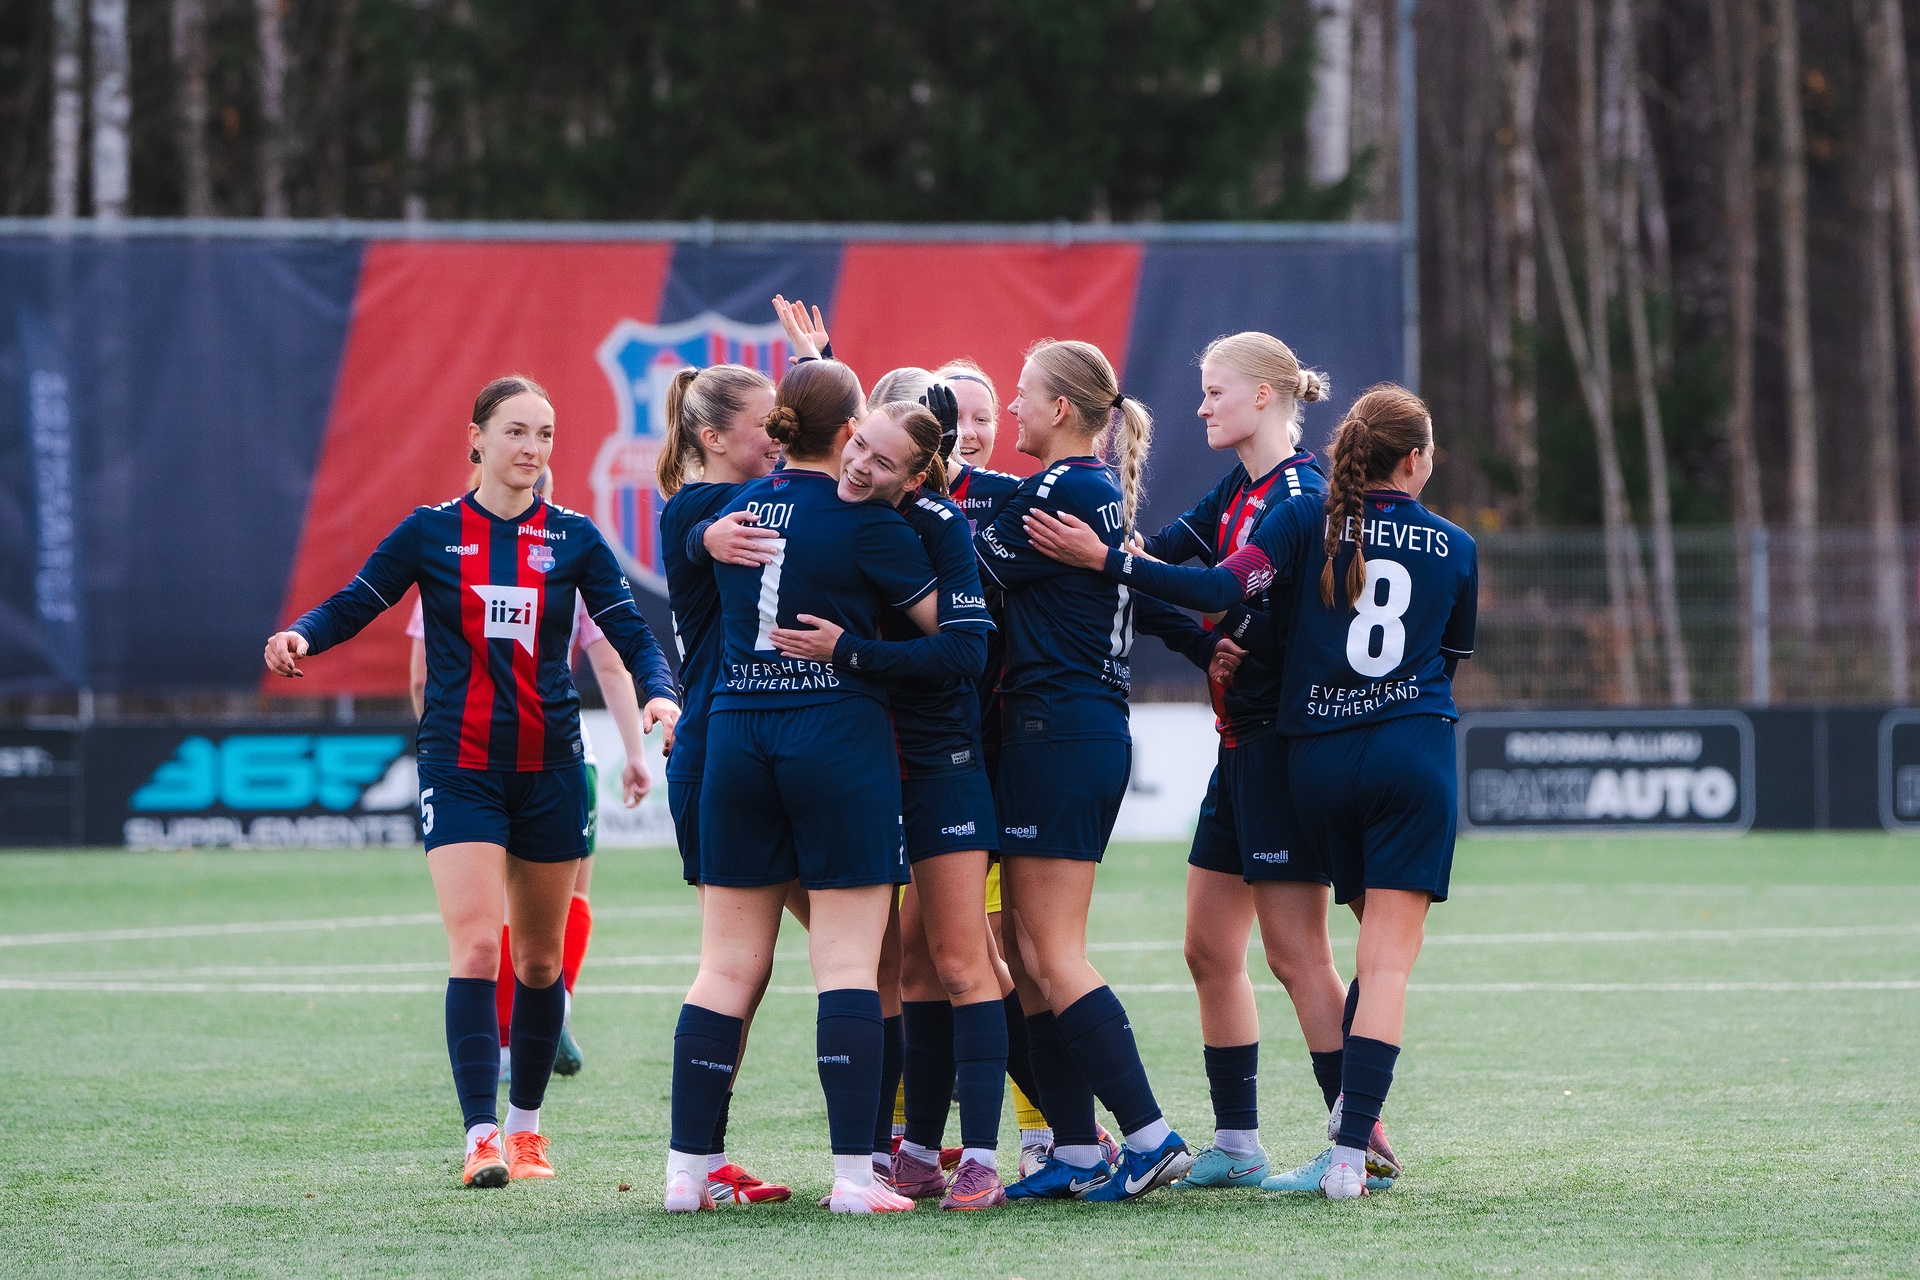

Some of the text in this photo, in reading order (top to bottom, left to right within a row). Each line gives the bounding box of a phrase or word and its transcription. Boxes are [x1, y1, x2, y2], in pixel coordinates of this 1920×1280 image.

[953, 497, 993, 509] letilevi
[741, 501, 795, 529] RODI
[517, 524, 567, 541] piletilevi
[445, 543, 479, 555] capelli
[491, 600, 532, 626] iizi
[1346, 558, 1412, 678] 8
[731, 660, 834, 678] EVERSHEDS
[726, 674, 840, 690] SUTHERLAND
[1307, 685, 1420, 718] SUTHERLAND
[420, 787, 435, 836] 5
[941, 821, 976, 836] capelli
[1005, 825, 1038, 838] capelli
[1252, 850, 1289, 862] capelli
